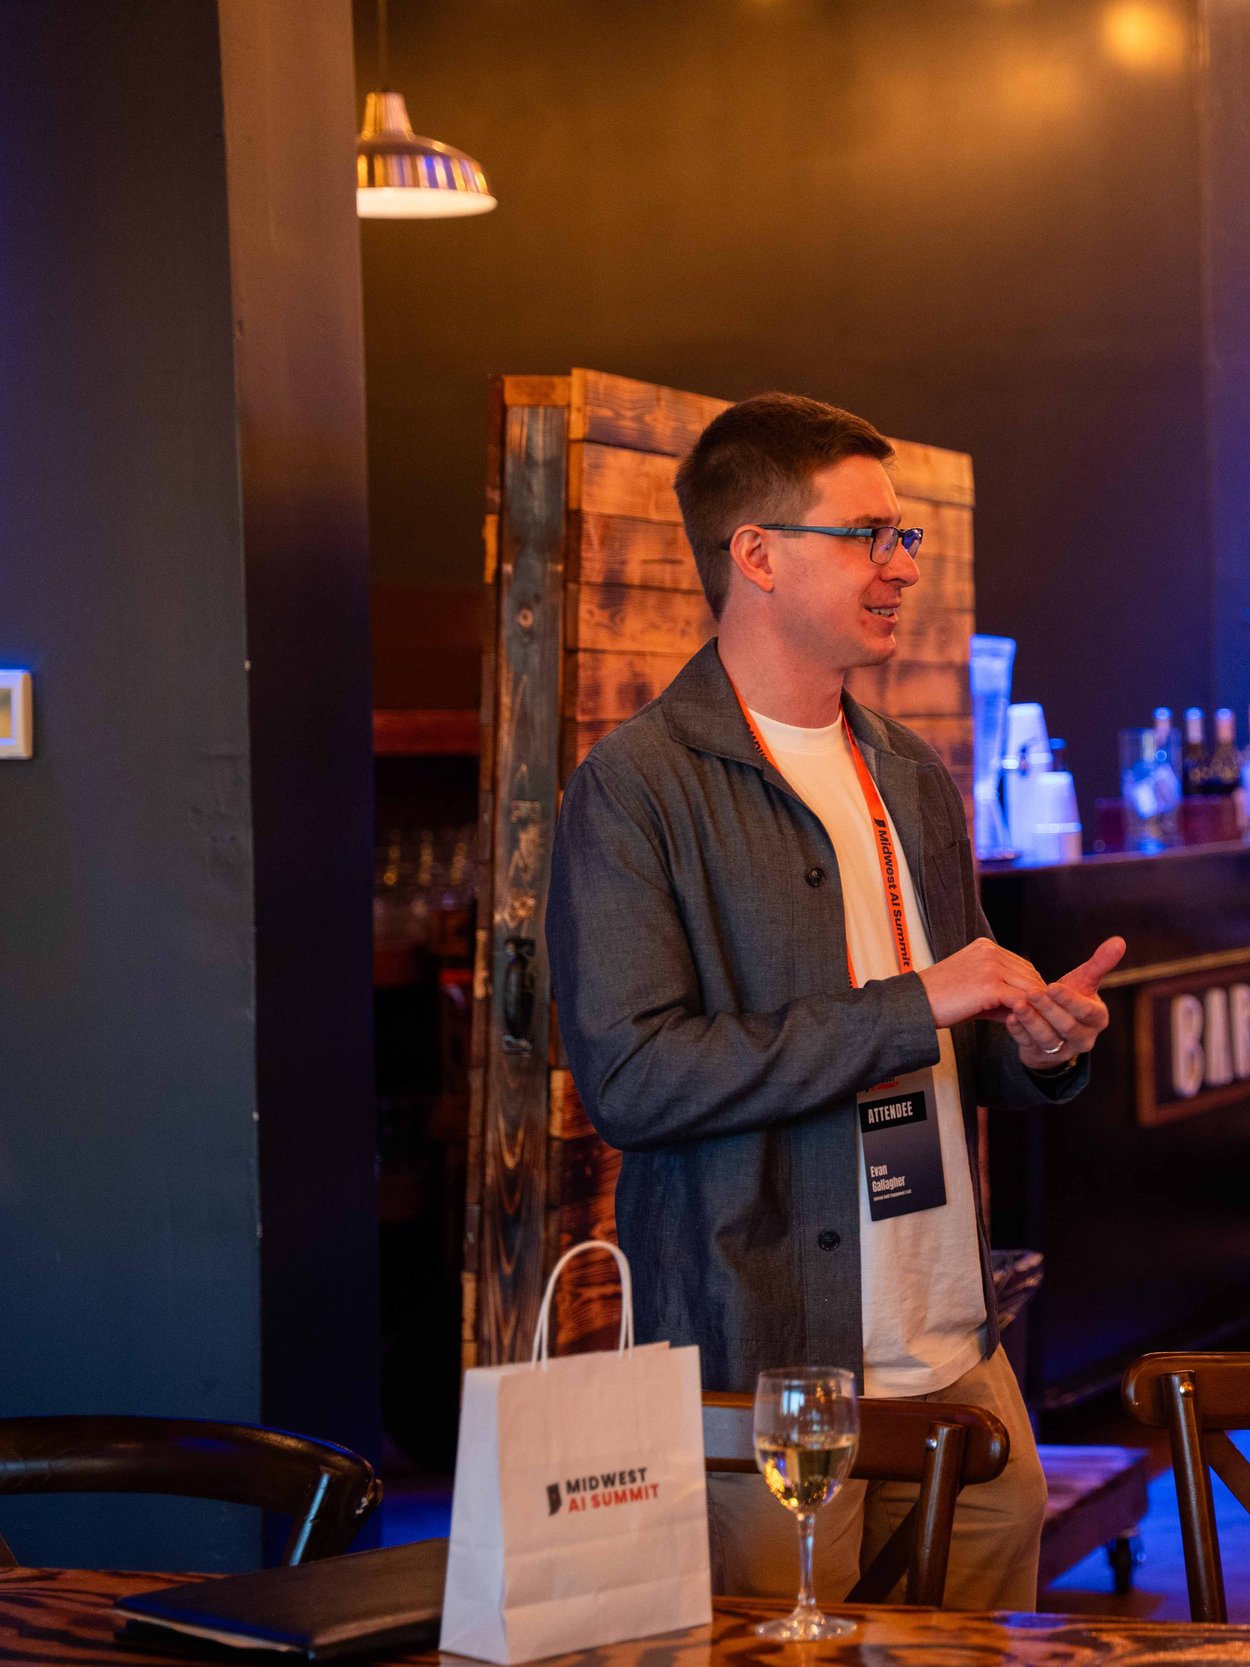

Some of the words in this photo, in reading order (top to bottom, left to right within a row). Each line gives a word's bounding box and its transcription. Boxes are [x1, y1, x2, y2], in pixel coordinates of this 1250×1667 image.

[878, 829, 897, 890] Midwest
[889, 892, 900, 907] AI
[893, 909, 911, 967] Summit
[868, 1101, 914, 1124] ATTENDEE
[870, 1164, 888, 1178] Evan
[872, 1176, 906, 1193] Gallagher
[565, 1467, 647, 1495] MIDWEST
[568, 1497, 586, 1513] AI
[590, 1483, 659, 1509] SUMMIT
